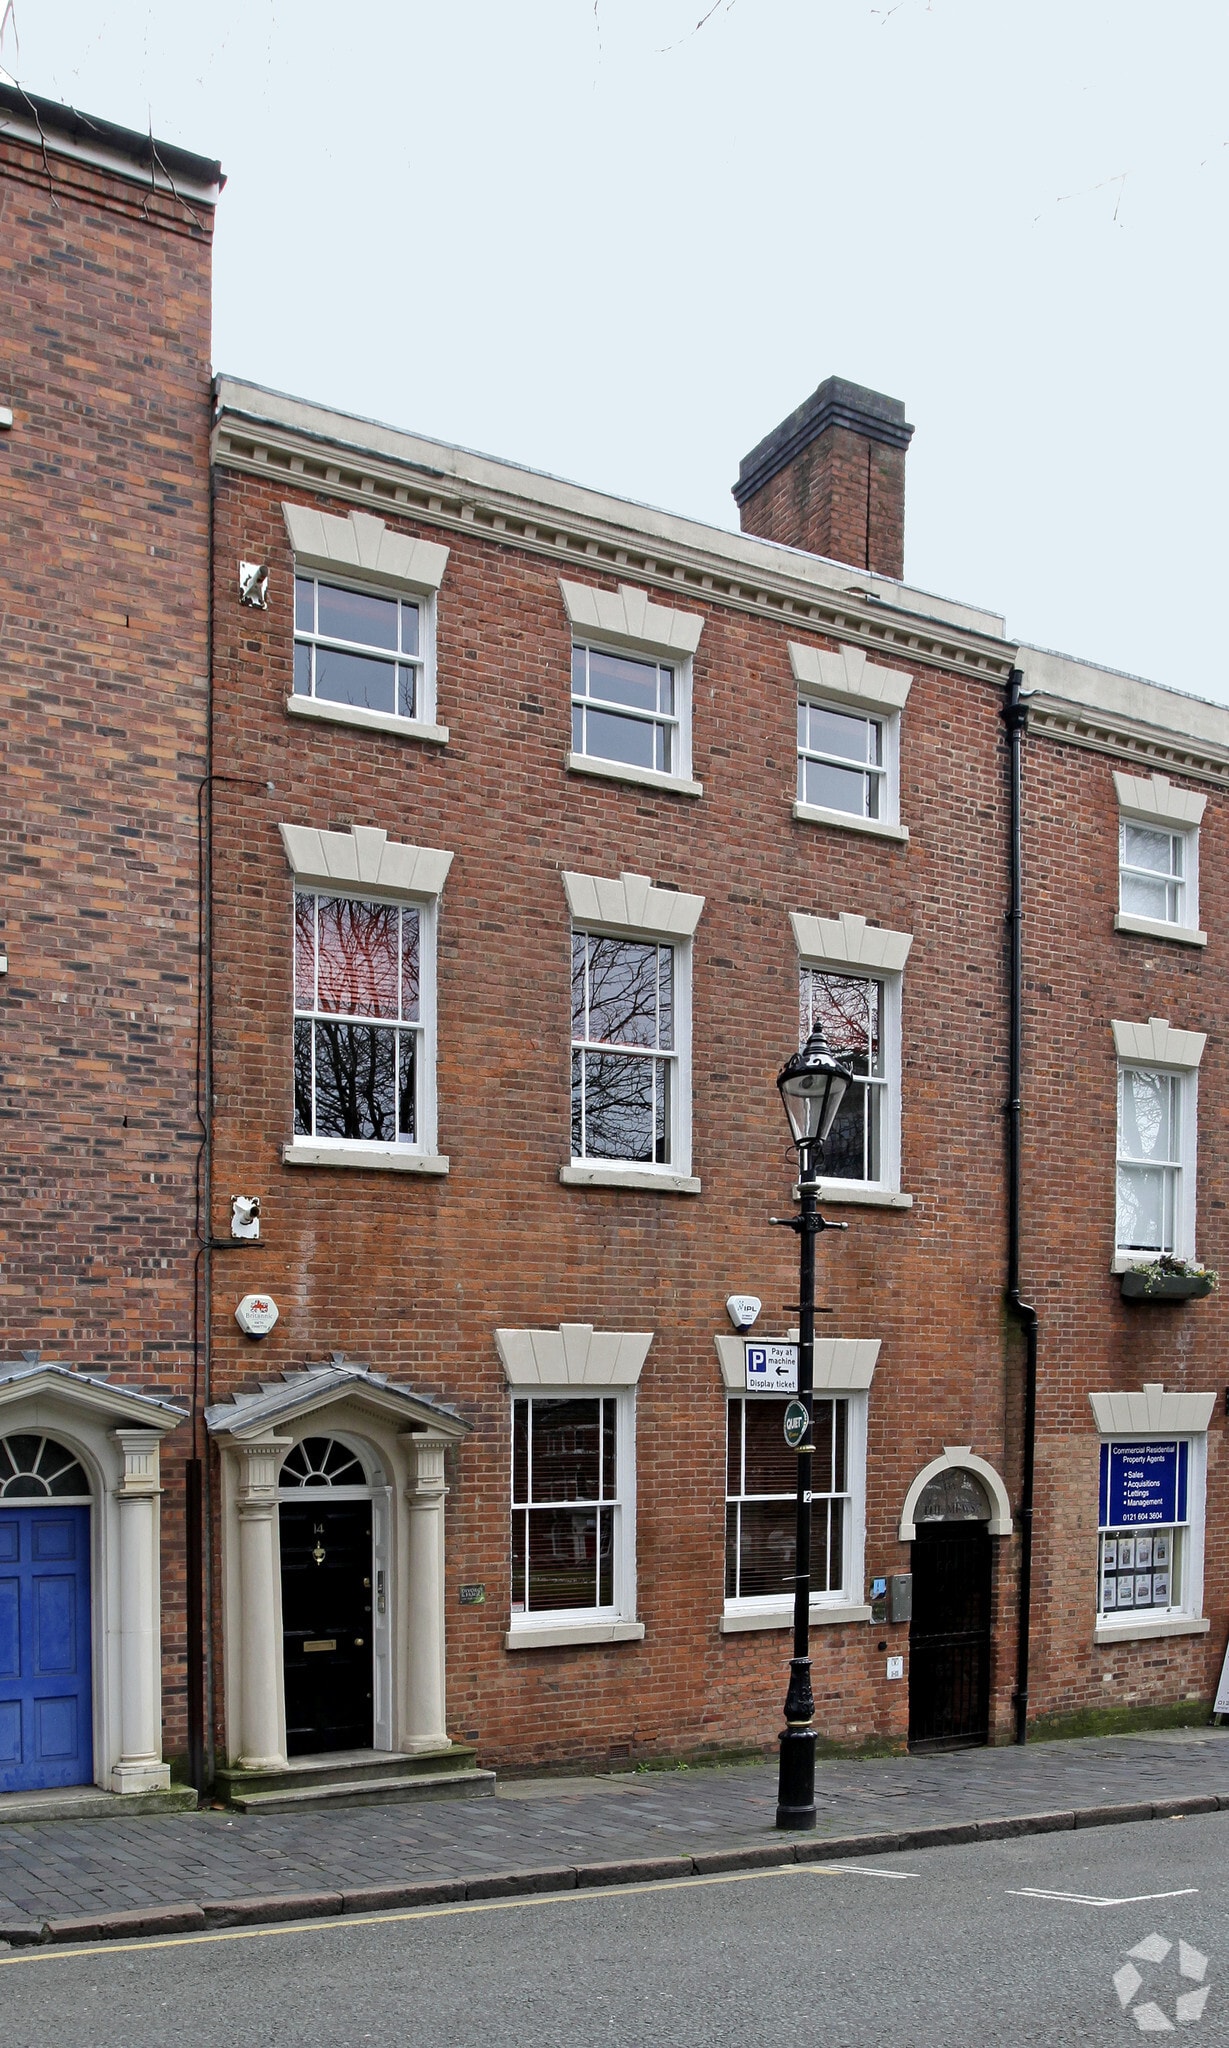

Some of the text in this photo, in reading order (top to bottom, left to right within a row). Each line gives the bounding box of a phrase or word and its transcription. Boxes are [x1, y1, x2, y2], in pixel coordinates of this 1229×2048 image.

[771, 1347, 784, 1356] Pay
[752, 1351, 764, 1371] P
[750, 1379, 775, 1389] Display
[786, 1416, 803, 1430] QUIET
[1122, 1455, 1165, 1464] Property Agents
[1127, 1480, 1161, 1488] Acquisitions
[1127, 1490, 1149, 1498] Lettings
[1127, 1498, 1163, 1507] Management
[313, 1523, 325, 1534] 14
